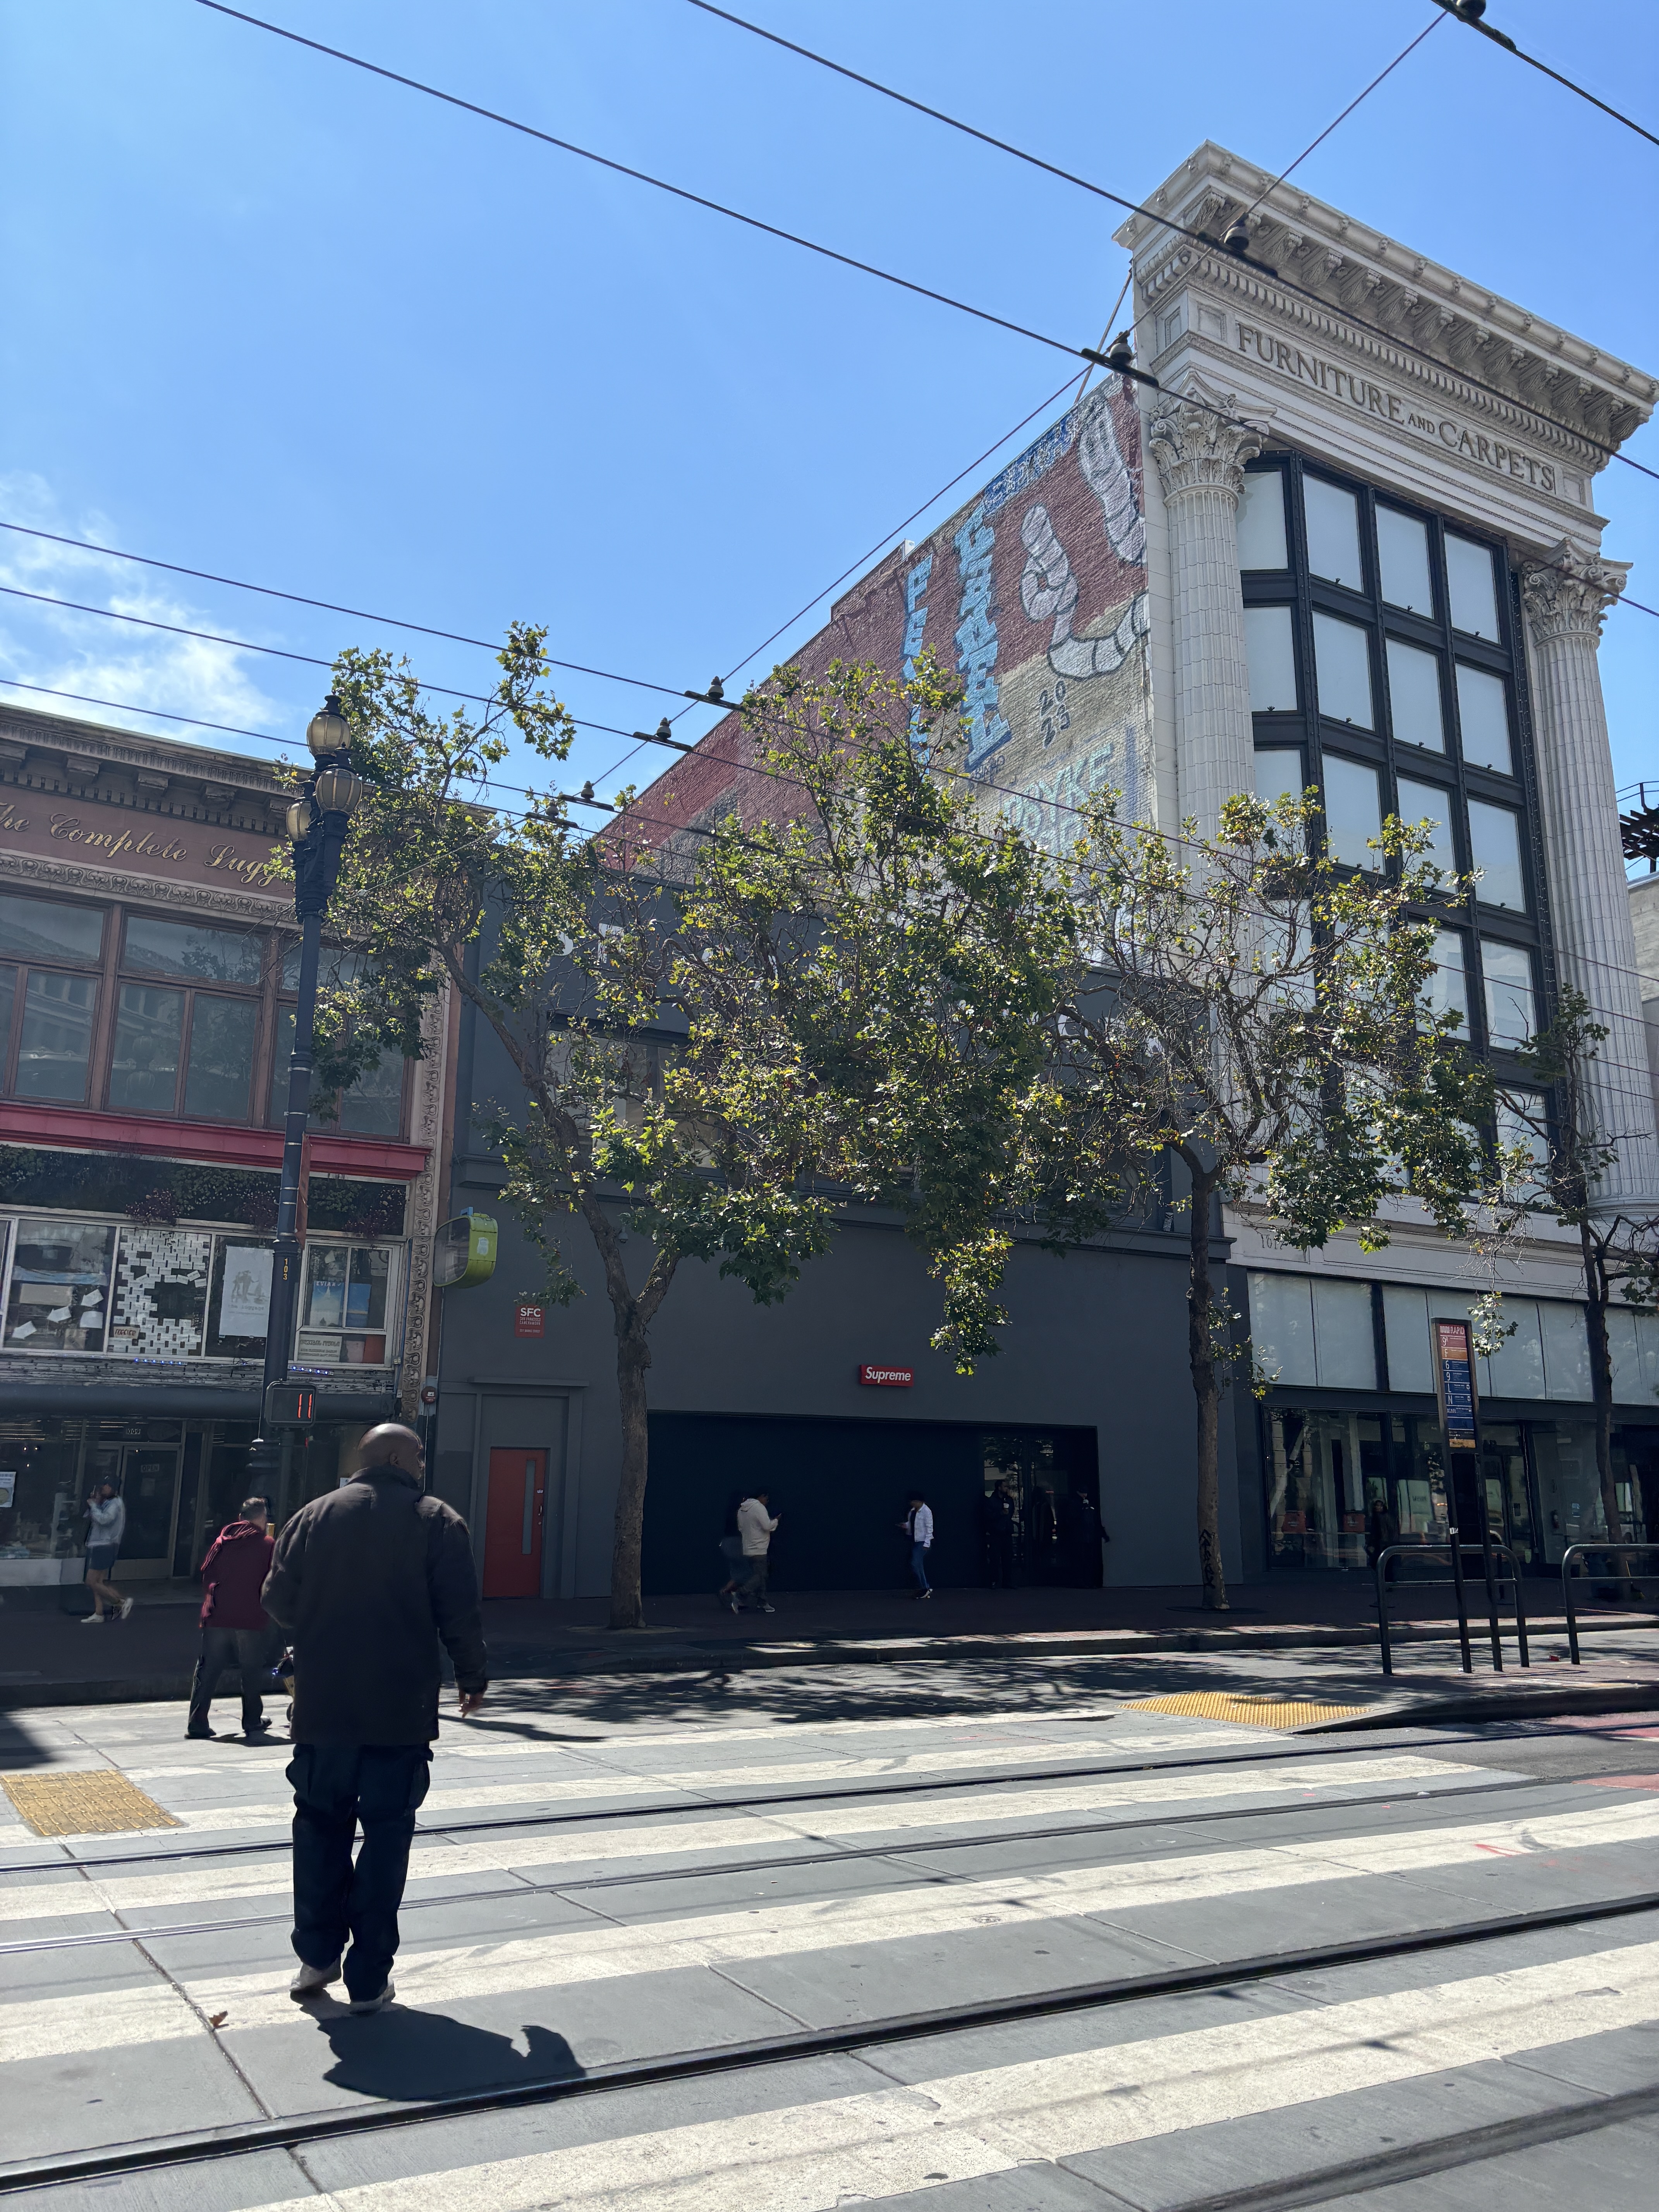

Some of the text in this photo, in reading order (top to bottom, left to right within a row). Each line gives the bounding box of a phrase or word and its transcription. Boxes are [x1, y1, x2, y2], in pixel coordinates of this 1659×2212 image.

[1238, 323, 1554, 491] FURNITURE AND CARPETS
[50, 812, 188, 861] Complete
[520, 1307, 541, 1317] SFC
[1450, 1326, 1465, 1334] RAPID
[1444, 1349, 1448, 1357] F
[1446, 1360, 1449, 1369] 6
[865, 1367, 911, 1383] Supreme
[1446, 1372, 1450, 1381] 9
[1448, 1383, 1451, 1393] L
[1448, 1395, 1453, 1404] N
[298, 1394, 312, 1418] 11
